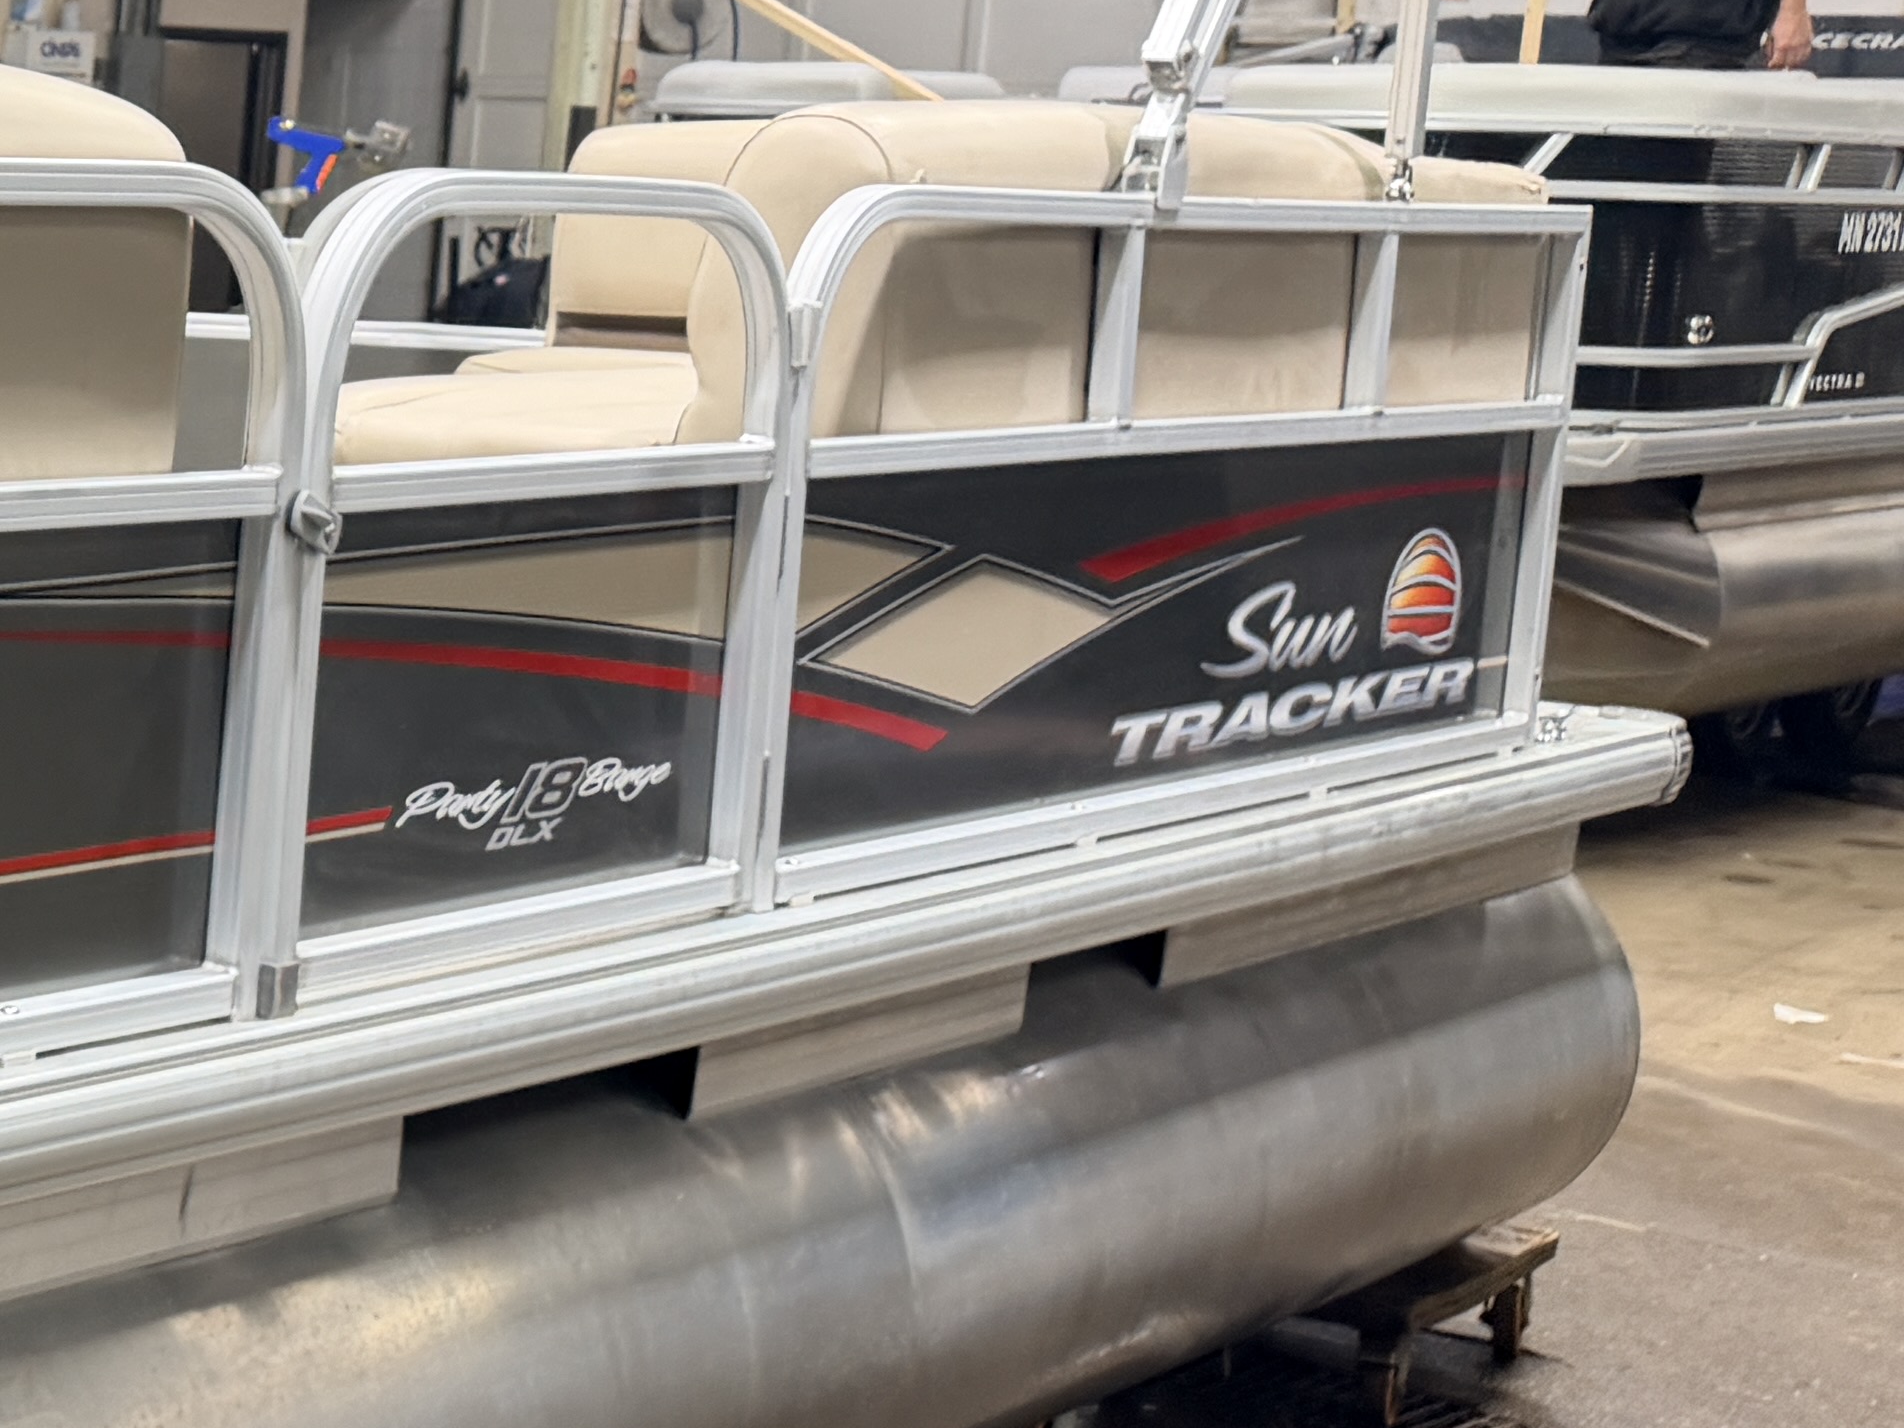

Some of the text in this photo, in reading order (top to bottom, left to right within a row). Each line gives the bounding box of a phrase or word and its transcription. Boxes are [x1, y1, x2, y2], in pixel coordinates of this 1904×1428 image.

[1200, 580, 1358, 679] Sun
[1110, 656, 1476, 768] TRACKER
[395, 756, 672, 830] Party 18 Barge
[485, 817, 564, 851] DLX
